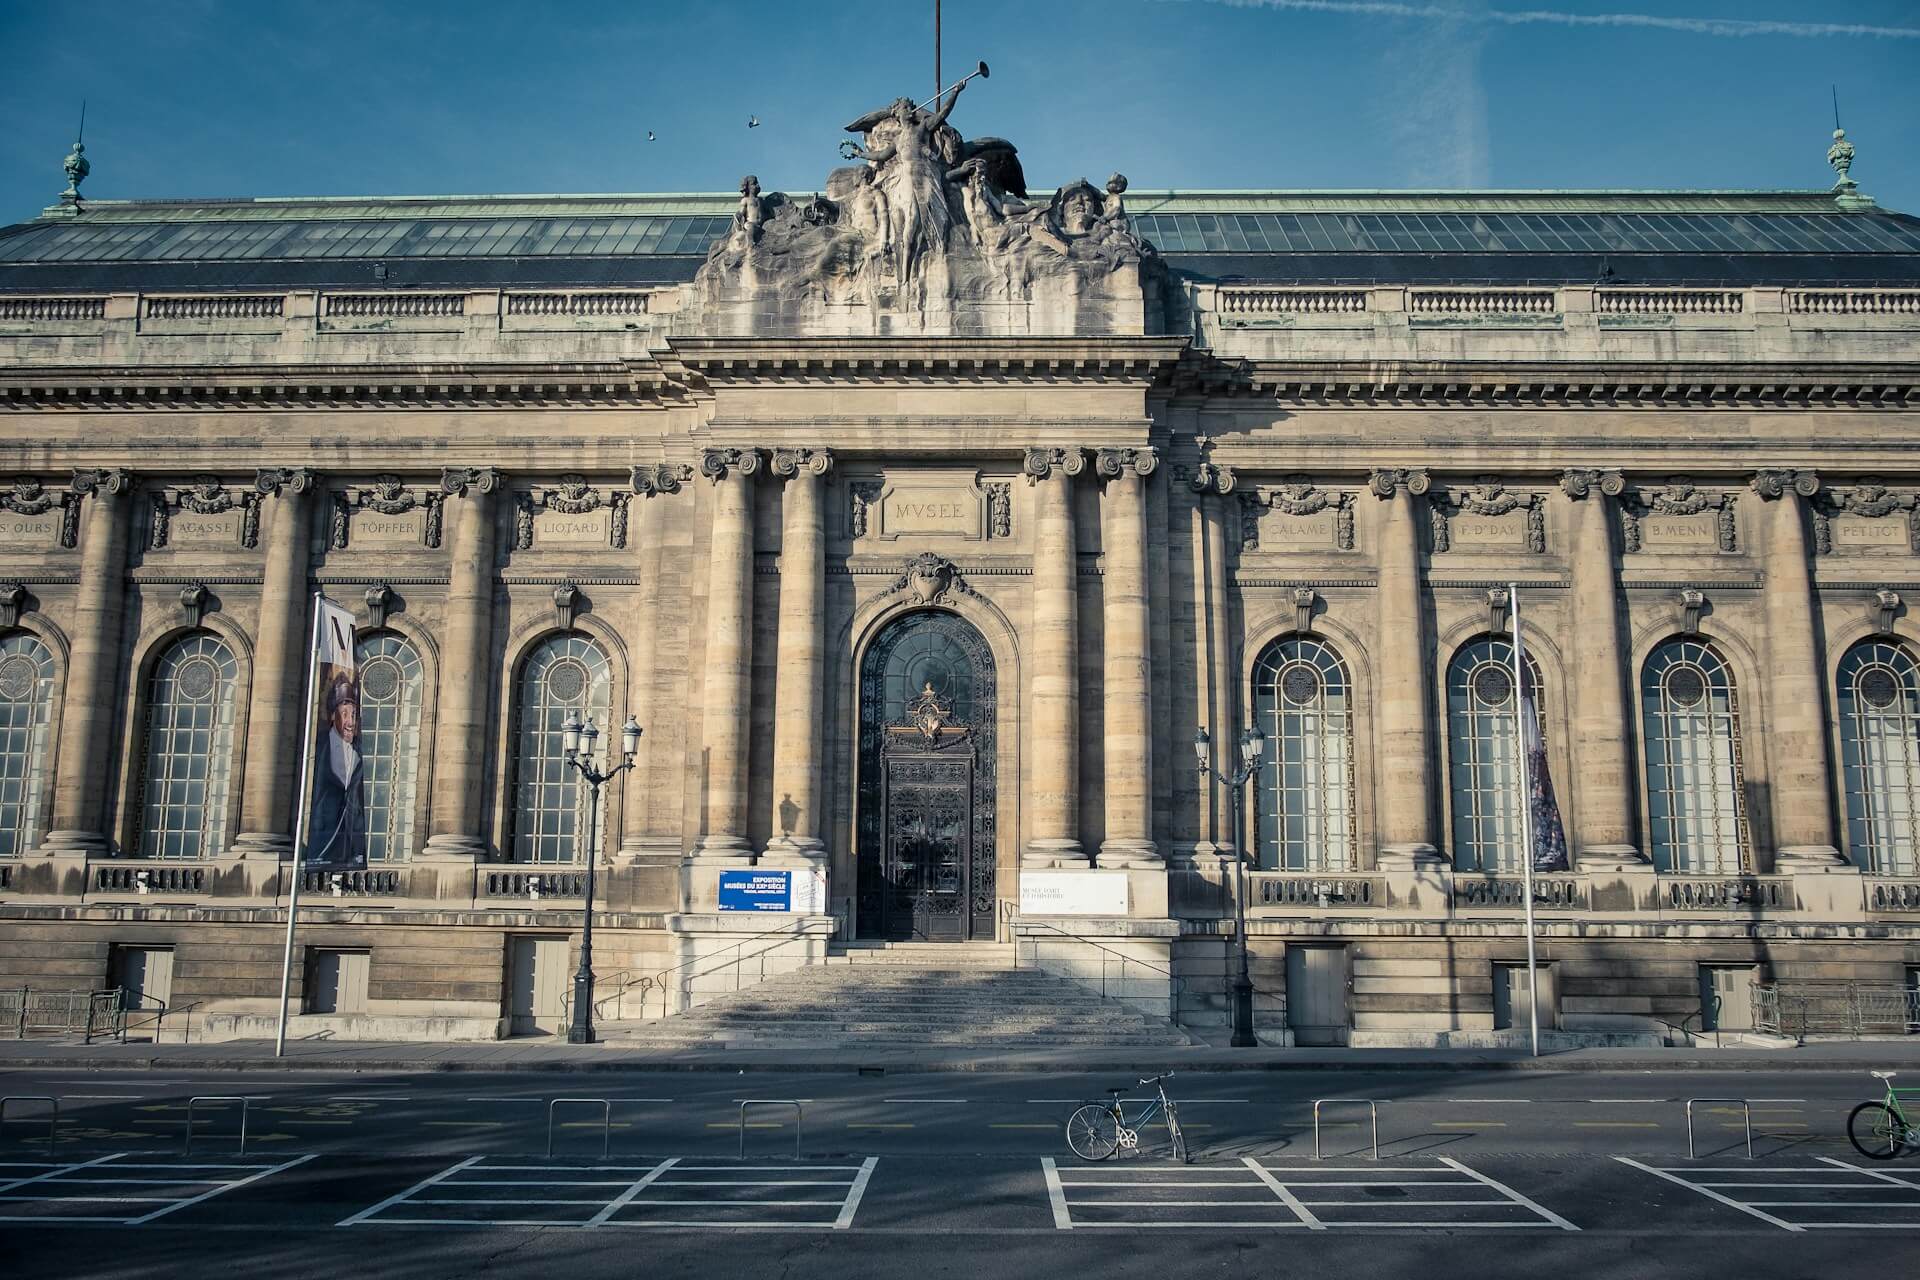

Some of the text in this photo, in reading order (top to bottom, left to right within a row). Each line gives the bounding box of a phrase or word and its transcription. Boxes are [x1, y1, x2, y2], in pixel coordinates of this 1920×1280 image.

[14, 523, 51, 532] OURS
[543, 522, 599, 533] LIOTARD
[1271, 524, 1327, 535] CALAME
[1843, 526, 1900, 536] PETITOT
[331, 616, 357, 668] M
